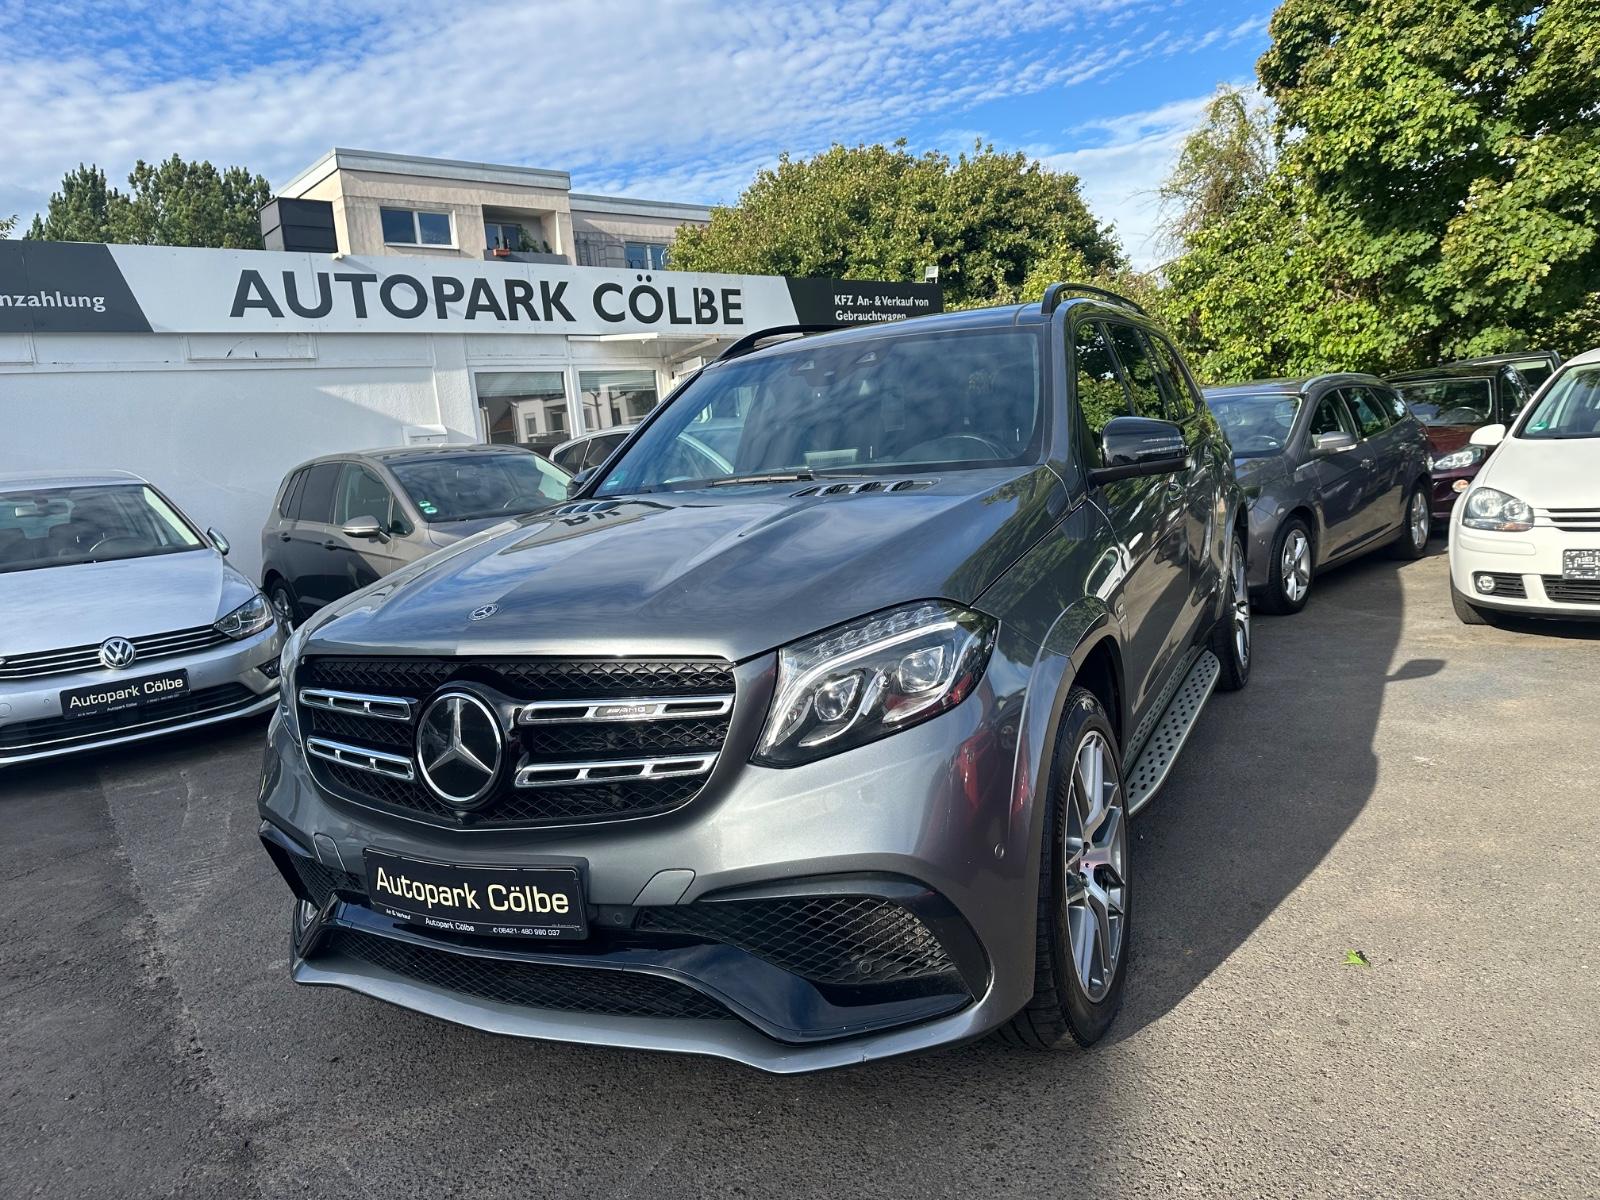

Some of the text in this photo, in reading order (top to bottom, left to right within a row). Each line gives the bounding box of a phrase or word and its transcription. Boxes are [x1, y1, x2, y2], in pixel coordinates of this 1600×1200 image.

[229, 268, 744, 325] AUTOPARK CÖLBE
[834, 294, 930, 307] KFZ An- & Verkauf von
[69, 685, 140, 709] Autopark
[143, 677, 184, 695] Cölbe
[618, 706, 646, 714] AMG
[376, 866, 569, 914] Autopark Cölbe
[425, 917, 455, 930] Autopark
